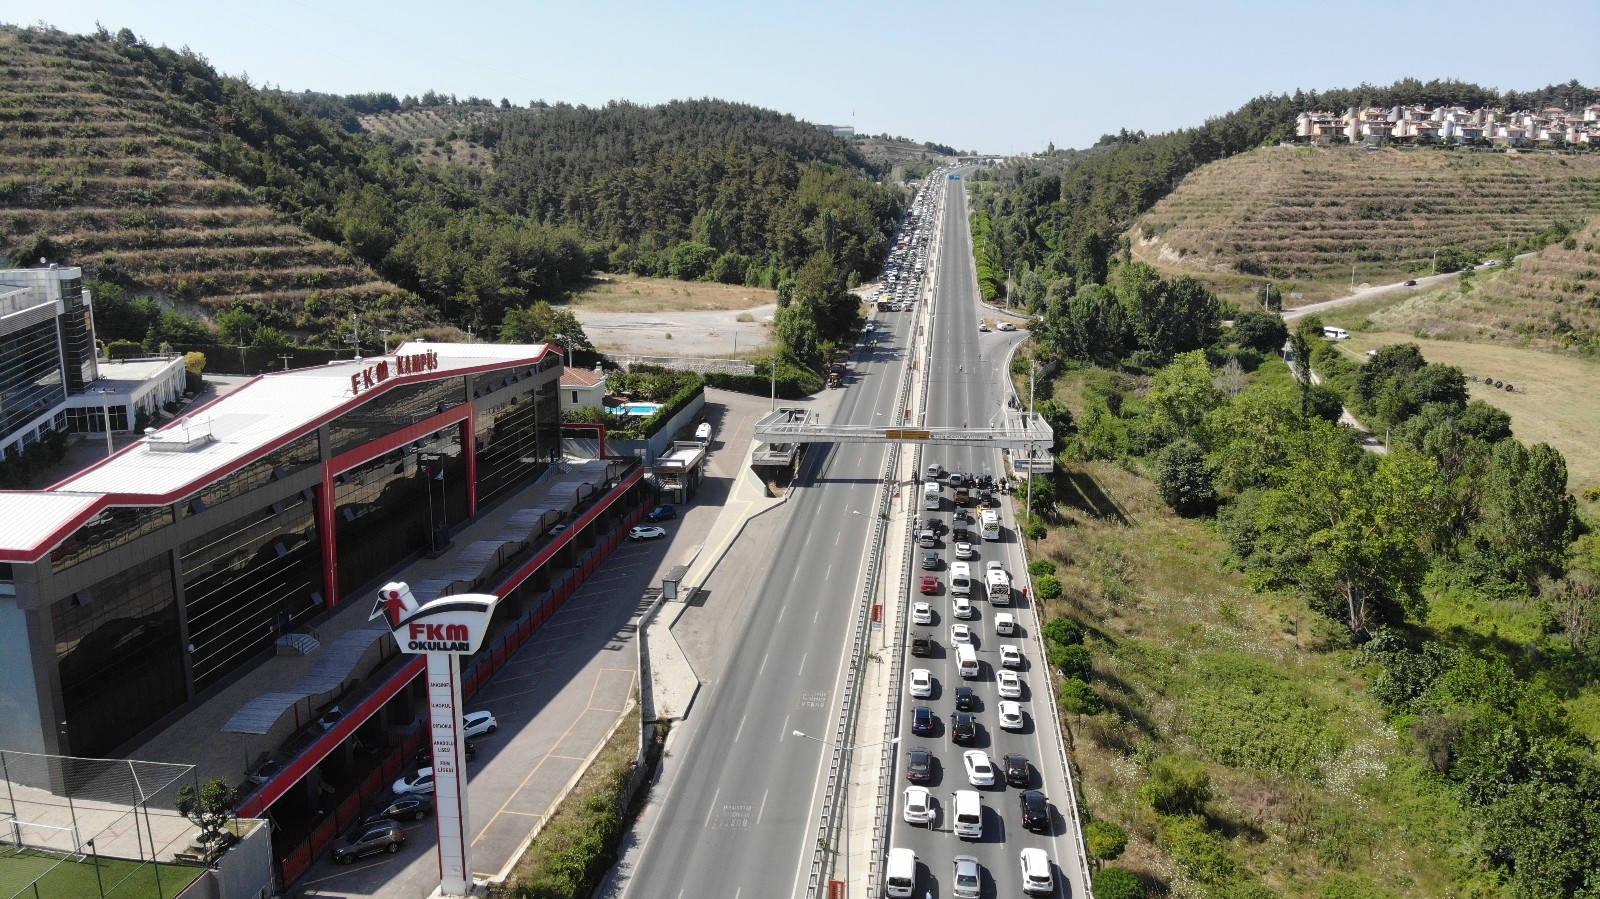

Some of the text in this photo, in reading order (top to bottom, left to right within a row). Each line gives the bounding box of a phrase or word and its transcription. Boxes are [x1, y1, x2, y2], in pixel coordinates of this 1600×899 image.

[351, 349, 438, 395] FKM KAMPÜS
[409, 623, 469, 641] FKM
[407, 641, 469, 651] OKULLARI
